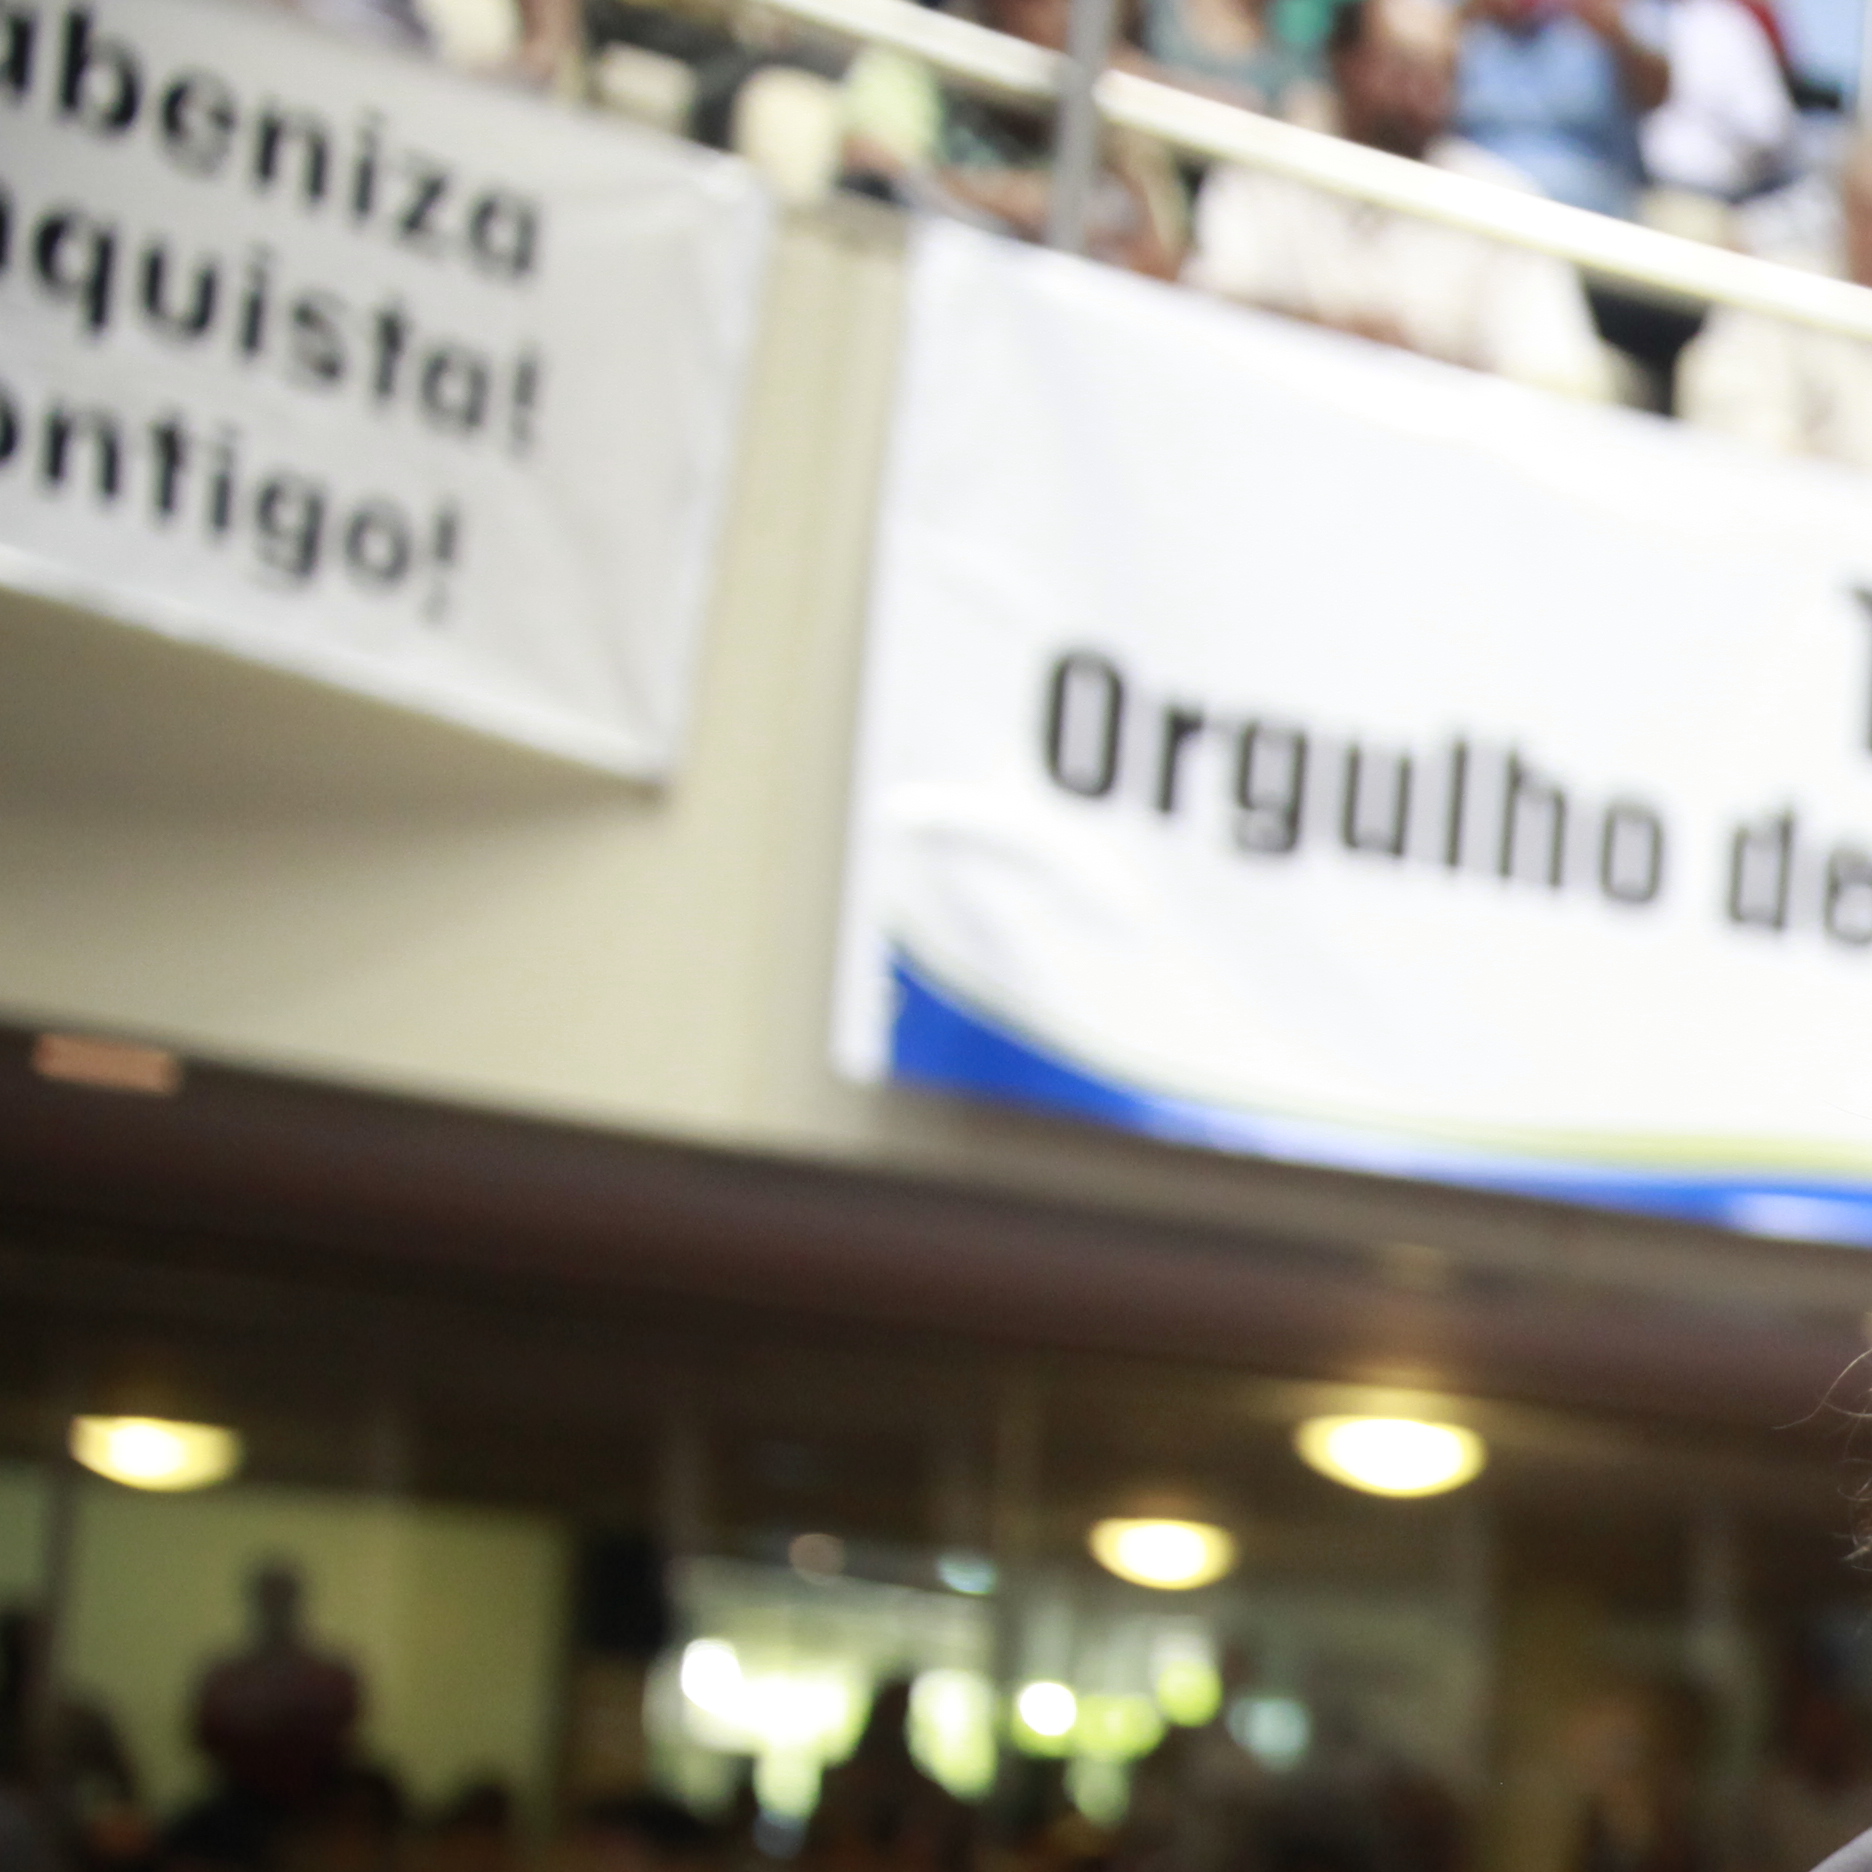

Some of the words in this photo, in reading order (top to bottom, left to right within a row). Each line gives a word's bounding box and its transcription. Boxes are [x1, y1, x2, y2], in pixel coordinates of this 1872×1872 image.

[0, 185, 544, 453] quista!
[0, 382, 464, 617] ntigo!
[1046, 648, 1664, 904] Orgulho
